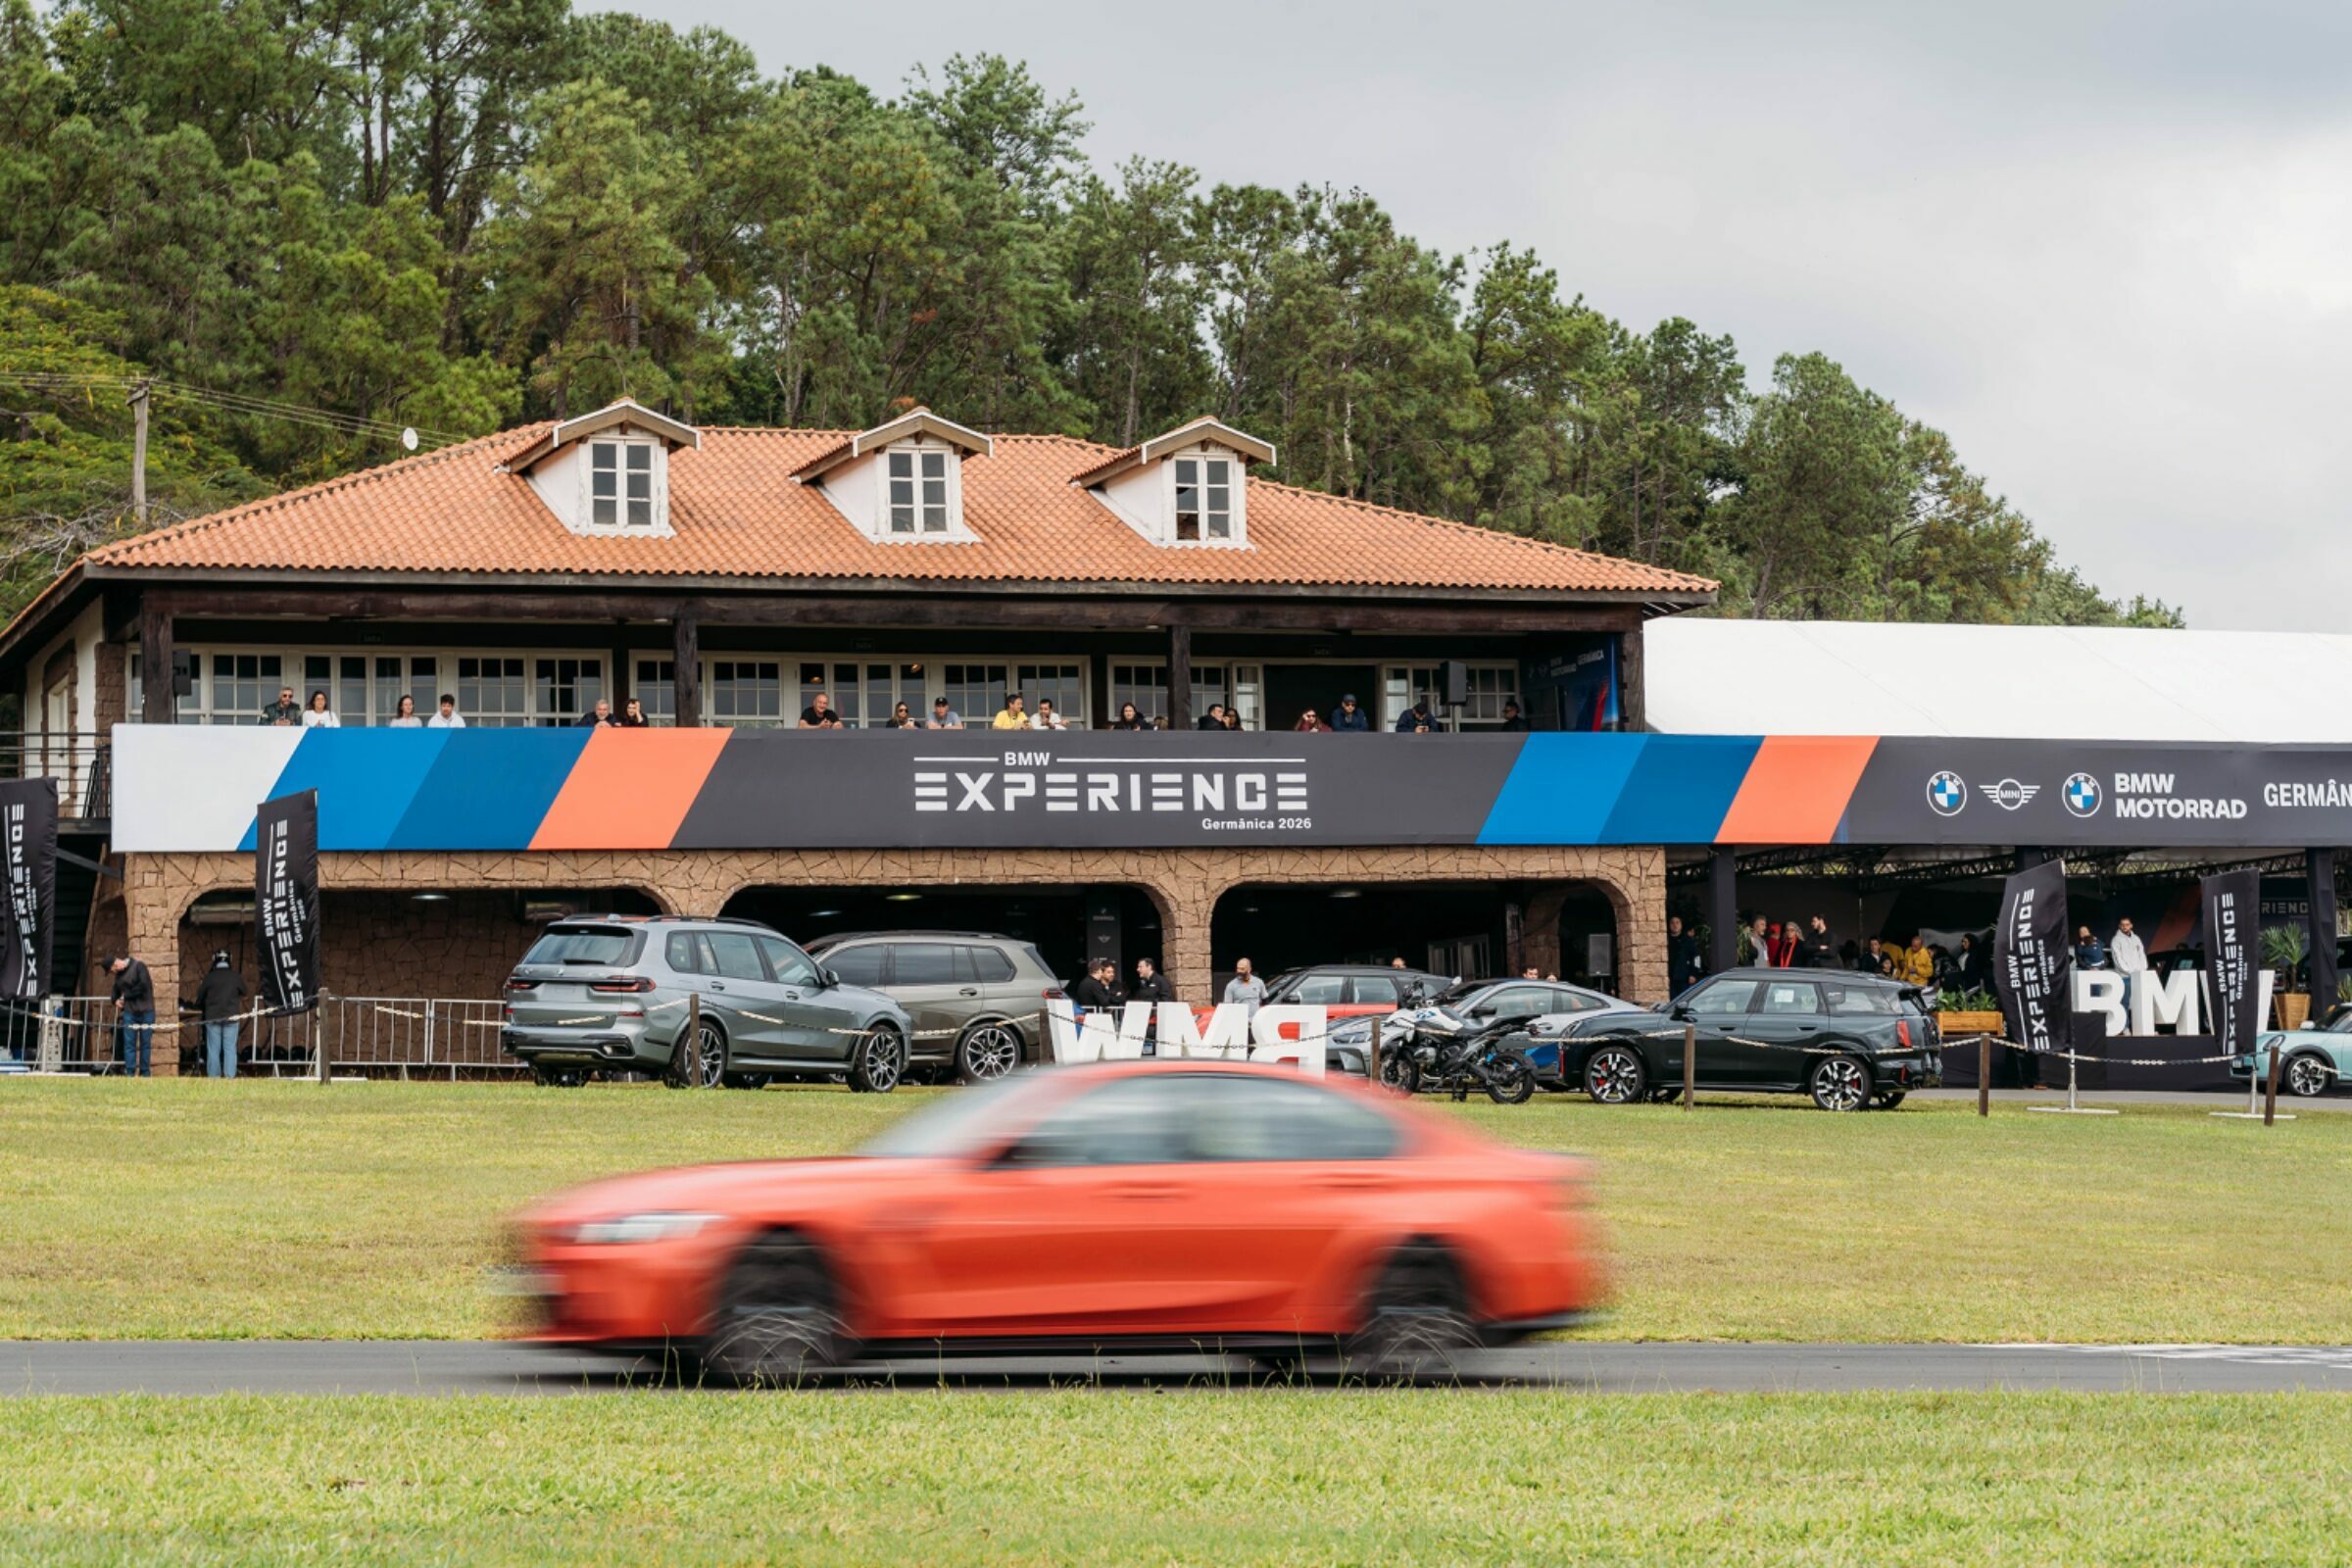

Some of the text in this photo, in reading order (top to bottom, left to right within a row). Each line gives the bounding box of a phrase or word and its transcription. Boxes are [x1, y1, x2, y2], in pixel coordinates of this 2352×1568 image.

[1004, 752, 1050, 765] BMW
[914, 772, 1307, 811] EXPERIENCE
[1999, 789, 2021, 800] MINI
[2114, 773, 2175, 793] BMW
[2264, 779, 2352, 808] GERMÂN
[1201, 817, 1311, 830] Germânica 2026
[2116, 798, 2247, 819] MOTORRAD
[12, 804, 37, 997] EXPERIENCE
[274, 819, 304, 1008] EXPERIENCE
[263, 898, 275, 938] BMW
[2007, 955, 2022, 989] BMW
[2018, 888, 2050, 1051] EXPERIENCE
[2215, 958, 2228, 993] BMW
